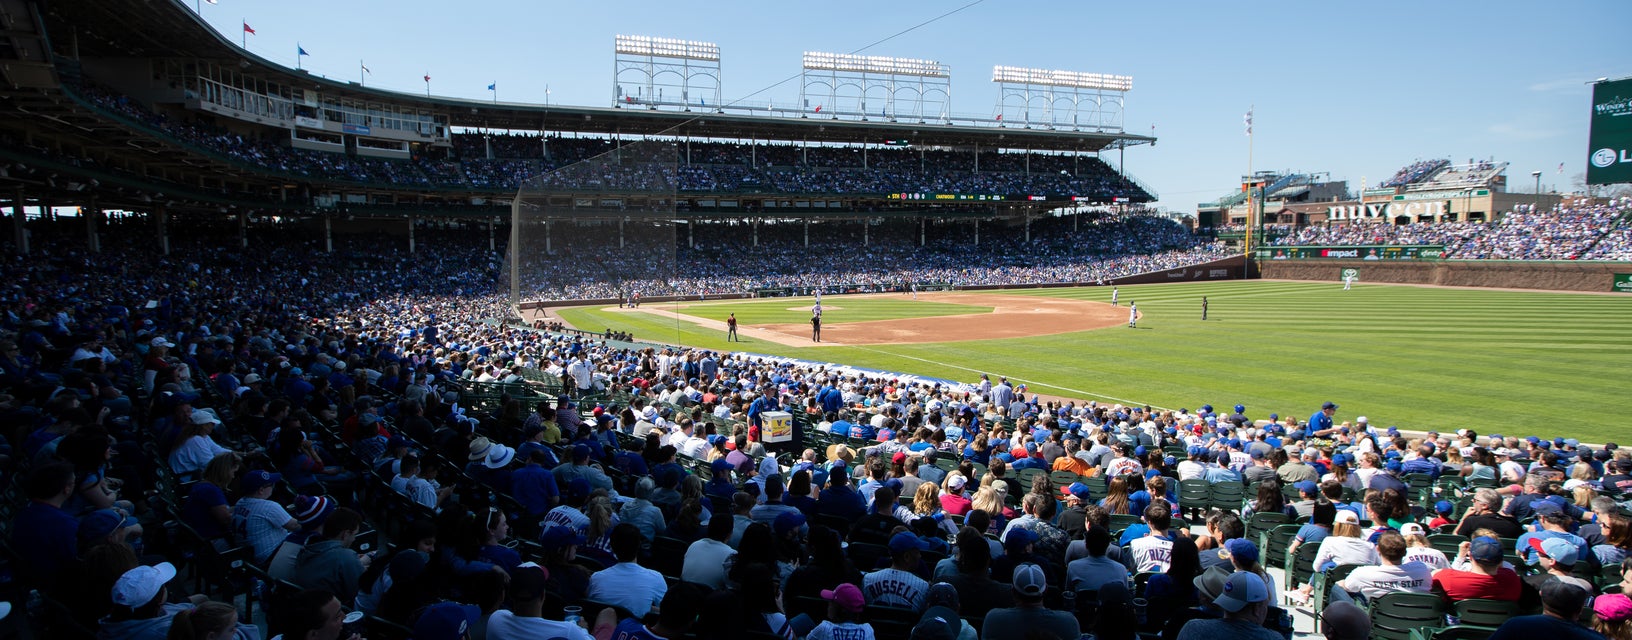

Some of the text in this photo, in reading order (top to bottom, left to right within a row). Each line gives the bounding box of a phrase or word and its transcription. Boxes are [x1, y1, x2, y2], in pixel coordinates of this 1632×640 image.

[1329, 200, 1446, 220] nuveen
[1327, 248, 1358, 257] impact
[1149, 548, 1171, 563] RIZZ
[1373, 579, 1424, 589] EVENT STAFF
[869, 580, 919, 604] RUSSELL
